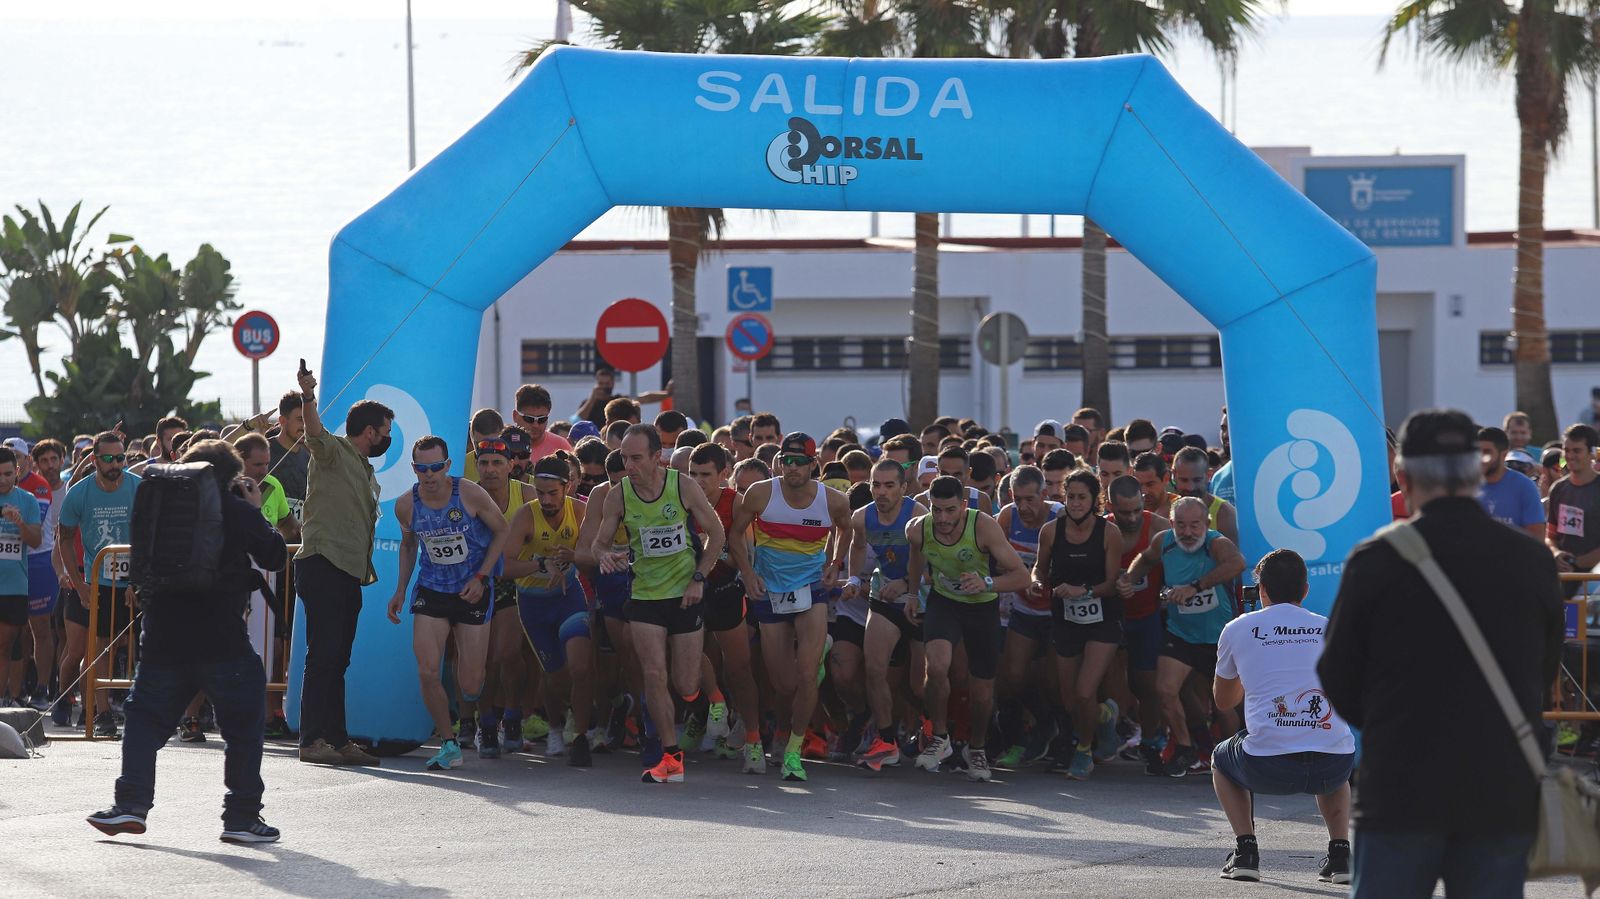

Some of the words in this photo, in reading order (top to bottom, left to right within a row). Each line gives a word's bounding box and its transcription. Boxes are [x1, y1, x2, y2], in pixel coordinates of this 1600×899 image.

[695, 70, 973, 120] SALIDA
[242, 328, 272, 344] BUS
[648, 533, 682, 549] 261
[432, 543, 464, 558] 391
[1068, 603, 1099, 617] 130
[1273, 625, 1323, 636] Muñoz
[1267, 711, 1297, 719] Turismo
[1274, 718, 1317, 729] Running
